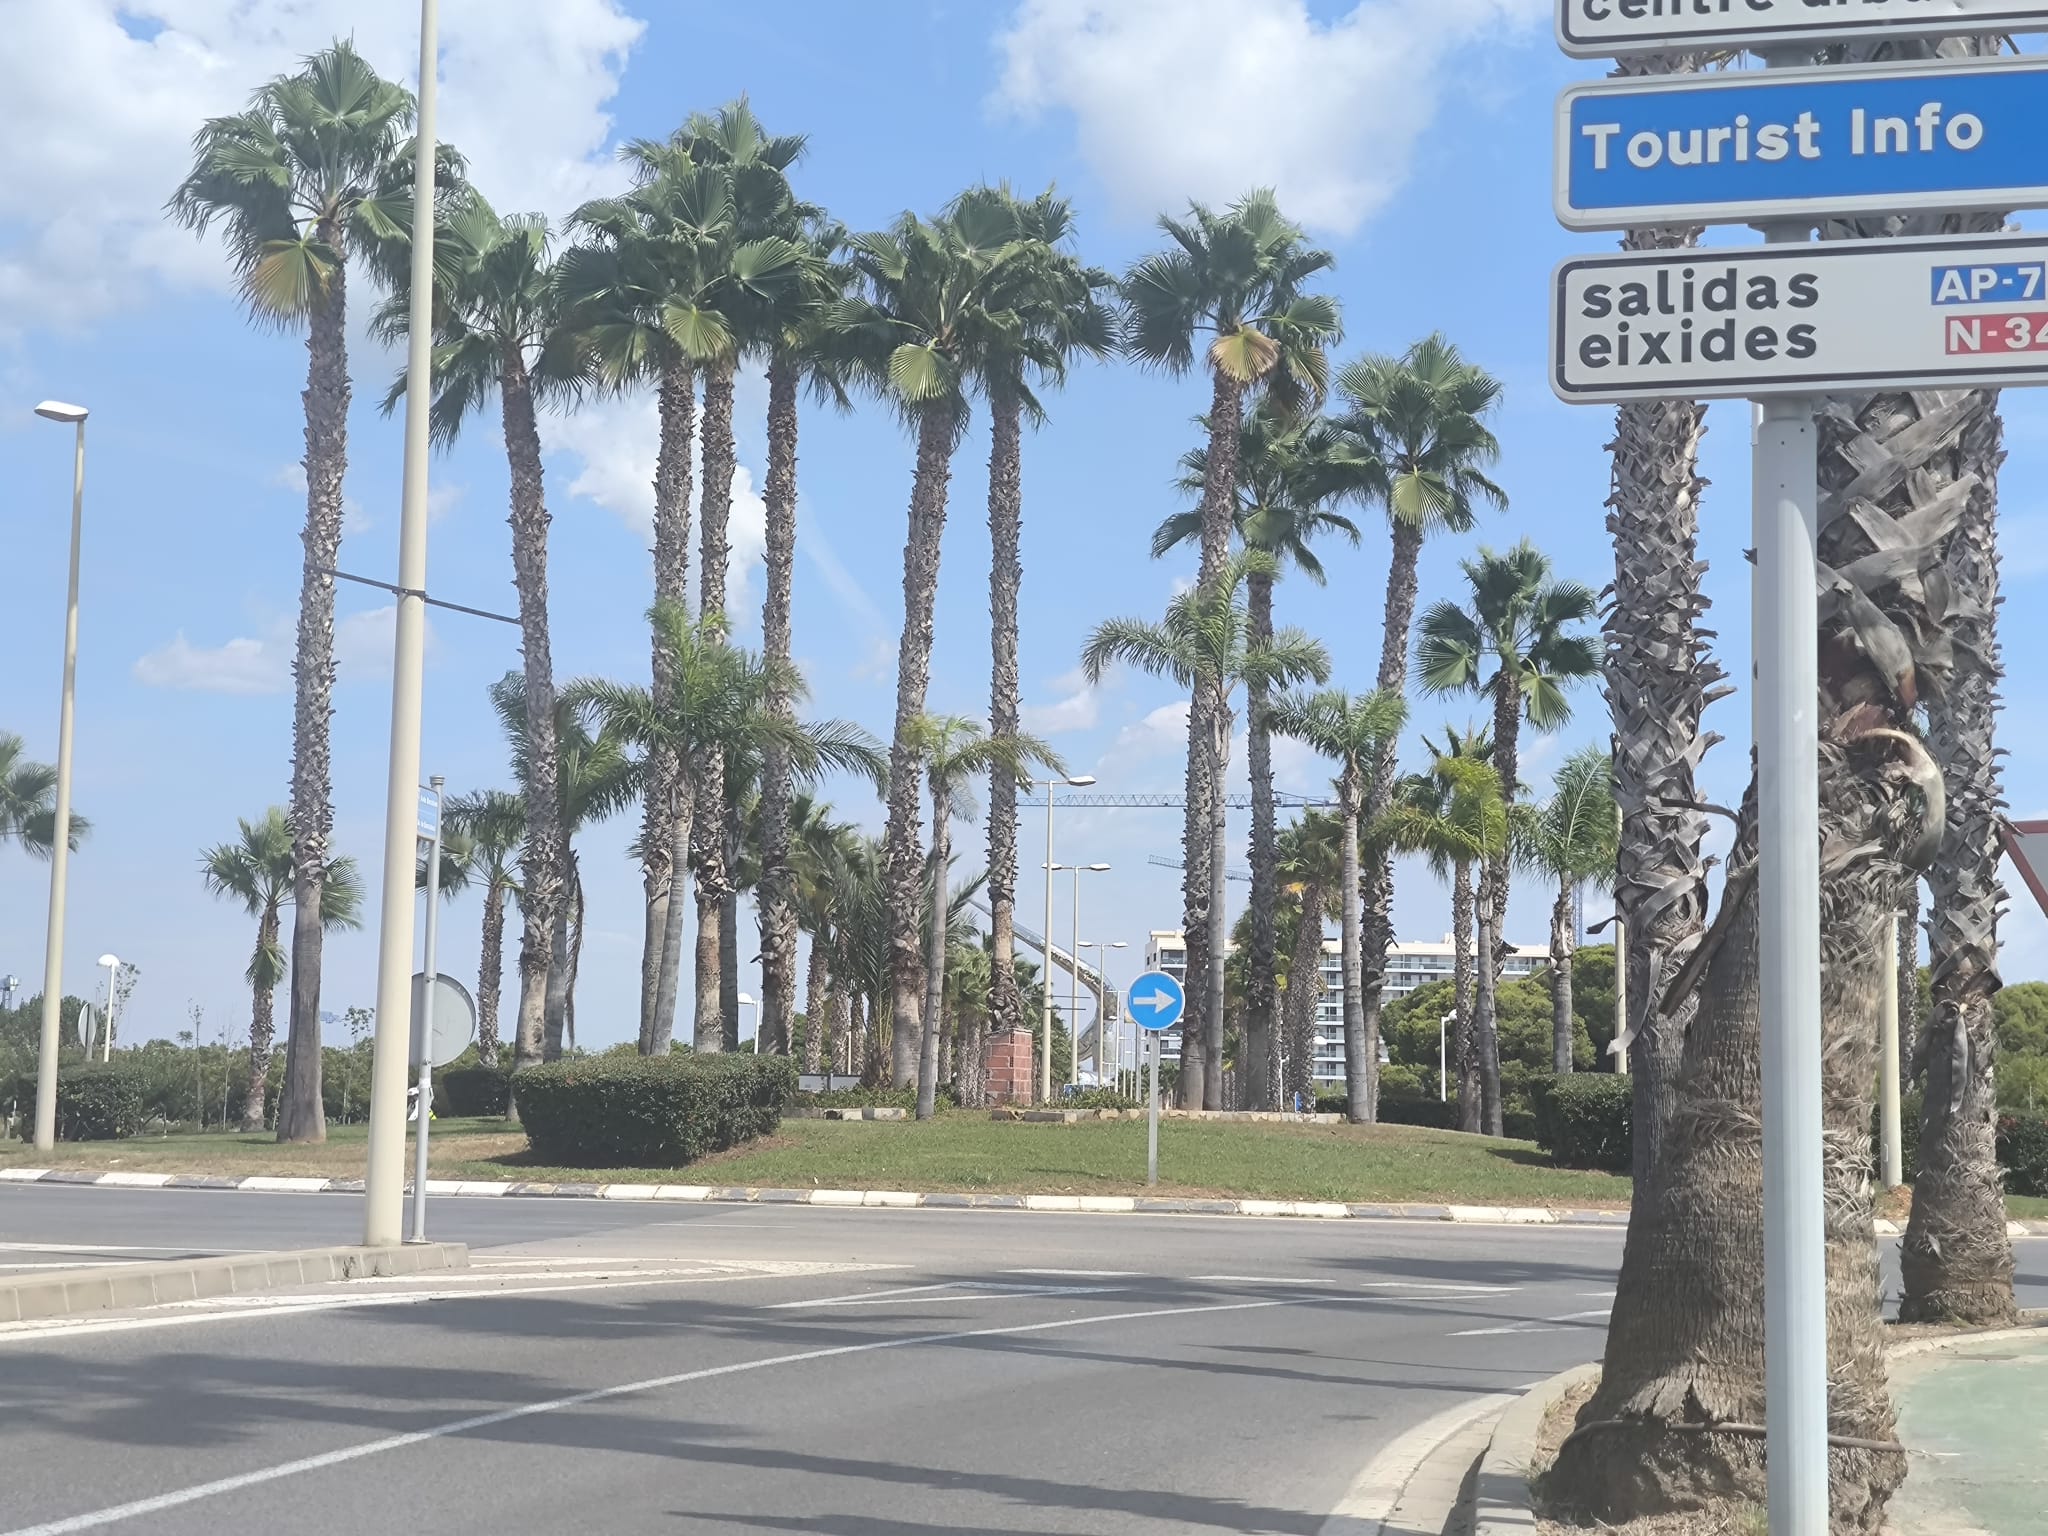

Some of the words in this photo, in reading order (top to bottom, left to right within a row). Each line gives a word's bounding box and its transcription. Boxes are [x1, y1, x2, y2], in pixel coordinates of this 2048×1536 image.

[1582, 111, 1820, 169] Tourist
[1852, 102, 1983, 154] Info
[1581, 267, 1819, 318] salidas
[1936, 266, 2041, 301] AP-7
[1579, 318, 1817, 368] eixides
